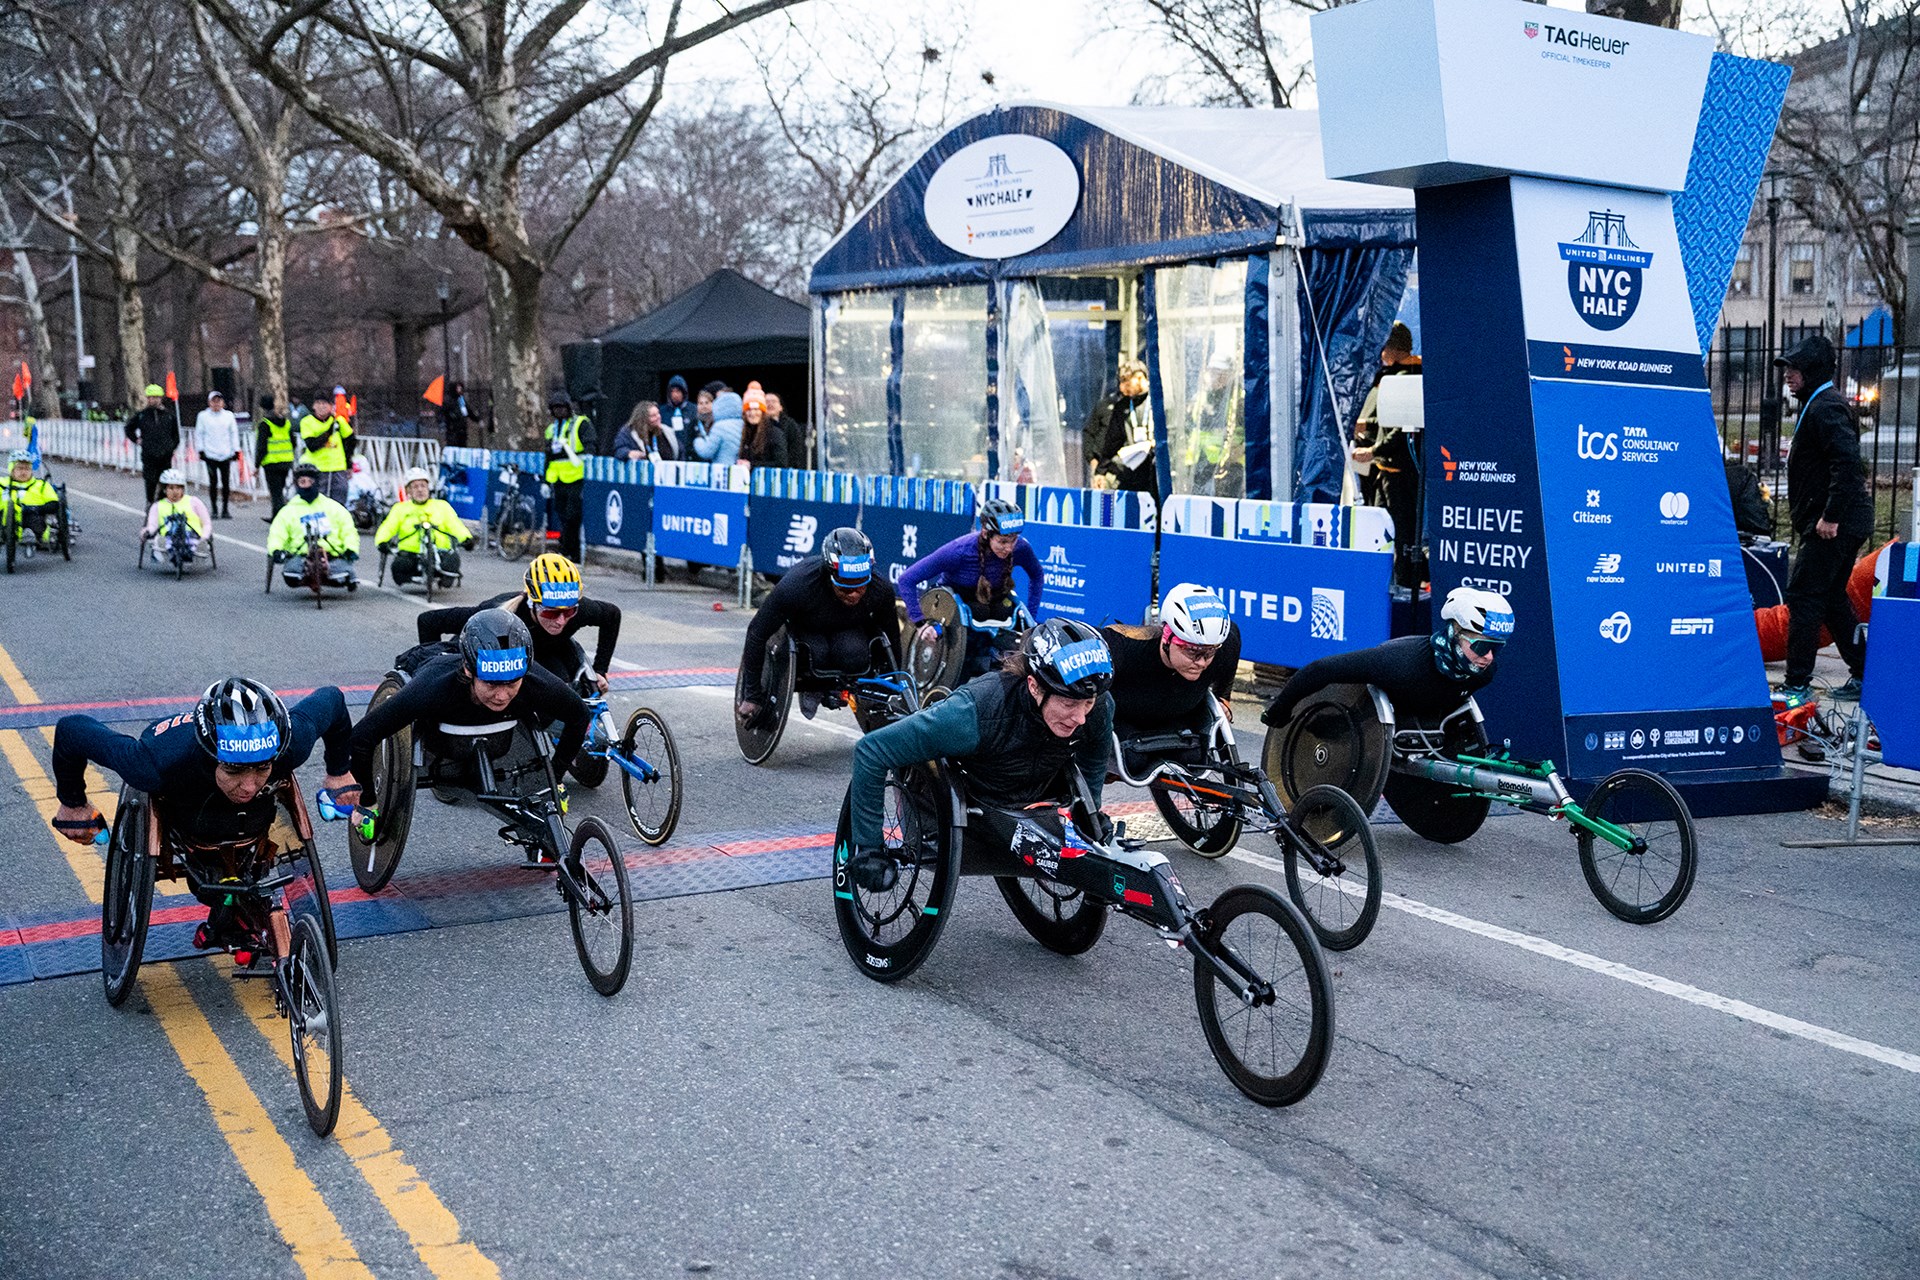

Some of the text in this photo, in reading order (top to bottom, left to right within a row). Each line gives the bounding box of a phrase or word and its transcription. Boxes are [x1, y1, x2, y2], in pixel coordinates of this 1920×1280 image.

[1541, 51, 1611, 69] OFFICIAL TIMEKEEPER
[1565, 248, 1646, 264] UNITED AIRLINES
[1578, 267, 1632, 296] NYC
[1582, 296, 1628, 317] HALF
[1577, 358, 1673, 374] NEW YORK ROAD RUNNERS
[1623, 426, 1648, 438] TATA
[1622, 439, 1680, 452] CONSULTANCY
[1622, 451, 1658, 463] SERVICES
[1458, 461, 1497, 472] NEW YORK
[1459, 472, 1516, 483] ROAD RUNNERS
[662, 514, 712, 536] UNITED
[1442, 506, 1524, 533] BELIEVE
[1573, 511, 1612, 524] Citizens
[1439, 540, 1532, 569] IN EVERY
[842, 562, 870, 573] WHEELER
[1656, 562, 1706, 574] UNITED
[1206, 586, 1302, 623] NITED
[1670, 618, 1714, 635] ESPN
[481, 658, 524, 673] DEDERICK
[1060, 649, 1108, 674] MCFADDEN
[220, 734, 278, 752] ELSHORBAGY
[1498, 778, 1532, 794] bromakin
[1036, 858, 1059, 870] SAUBER
